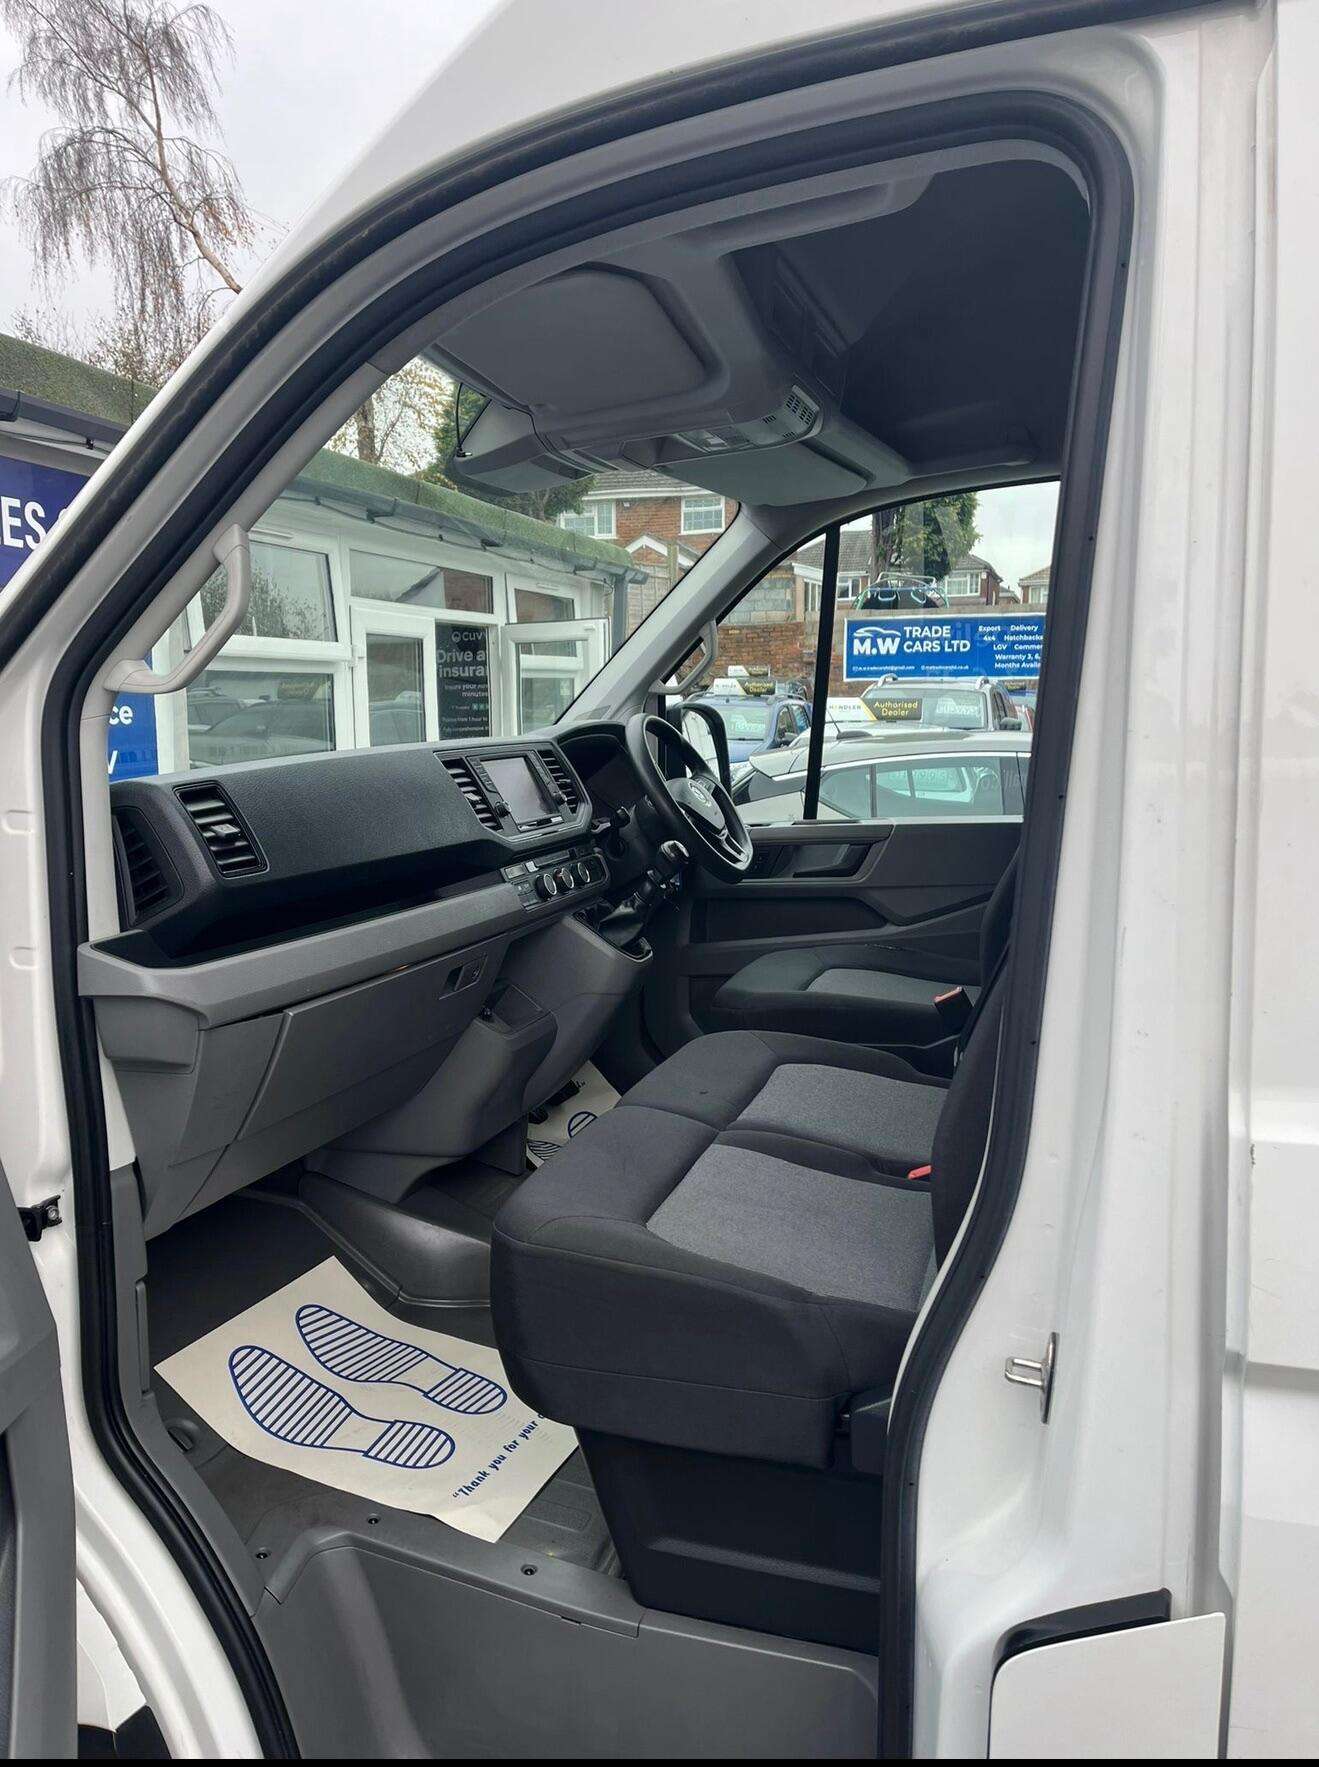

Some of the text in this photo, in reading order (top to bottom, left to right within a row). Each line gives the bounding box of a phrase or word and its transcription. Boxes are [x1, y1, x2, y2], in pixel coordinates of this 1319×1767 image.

[0, 496, 46, 551] ES
[903, 625, 951, 638] TRADE
[978, 624, 1039, 633] Export Delivery
[853, 637, 901, 656] M.W
[903, 640, 971, 653] CARS LTD
[993, 643, 1008, 651] LGV
[436, 649, 474, 663] Drive
[994, 653, 1027, 662] Warranty
[438, 665, 485, 678] insura
[994, 661, 1021, 669] Months
[874, 701, 918, 709] Authorised
[881, 708, 909, 717] Dealer
[488, 1454, 507, 1471] you
[502, 1439, 520, 1453] for
[518, 1420, 539, 1440] your
